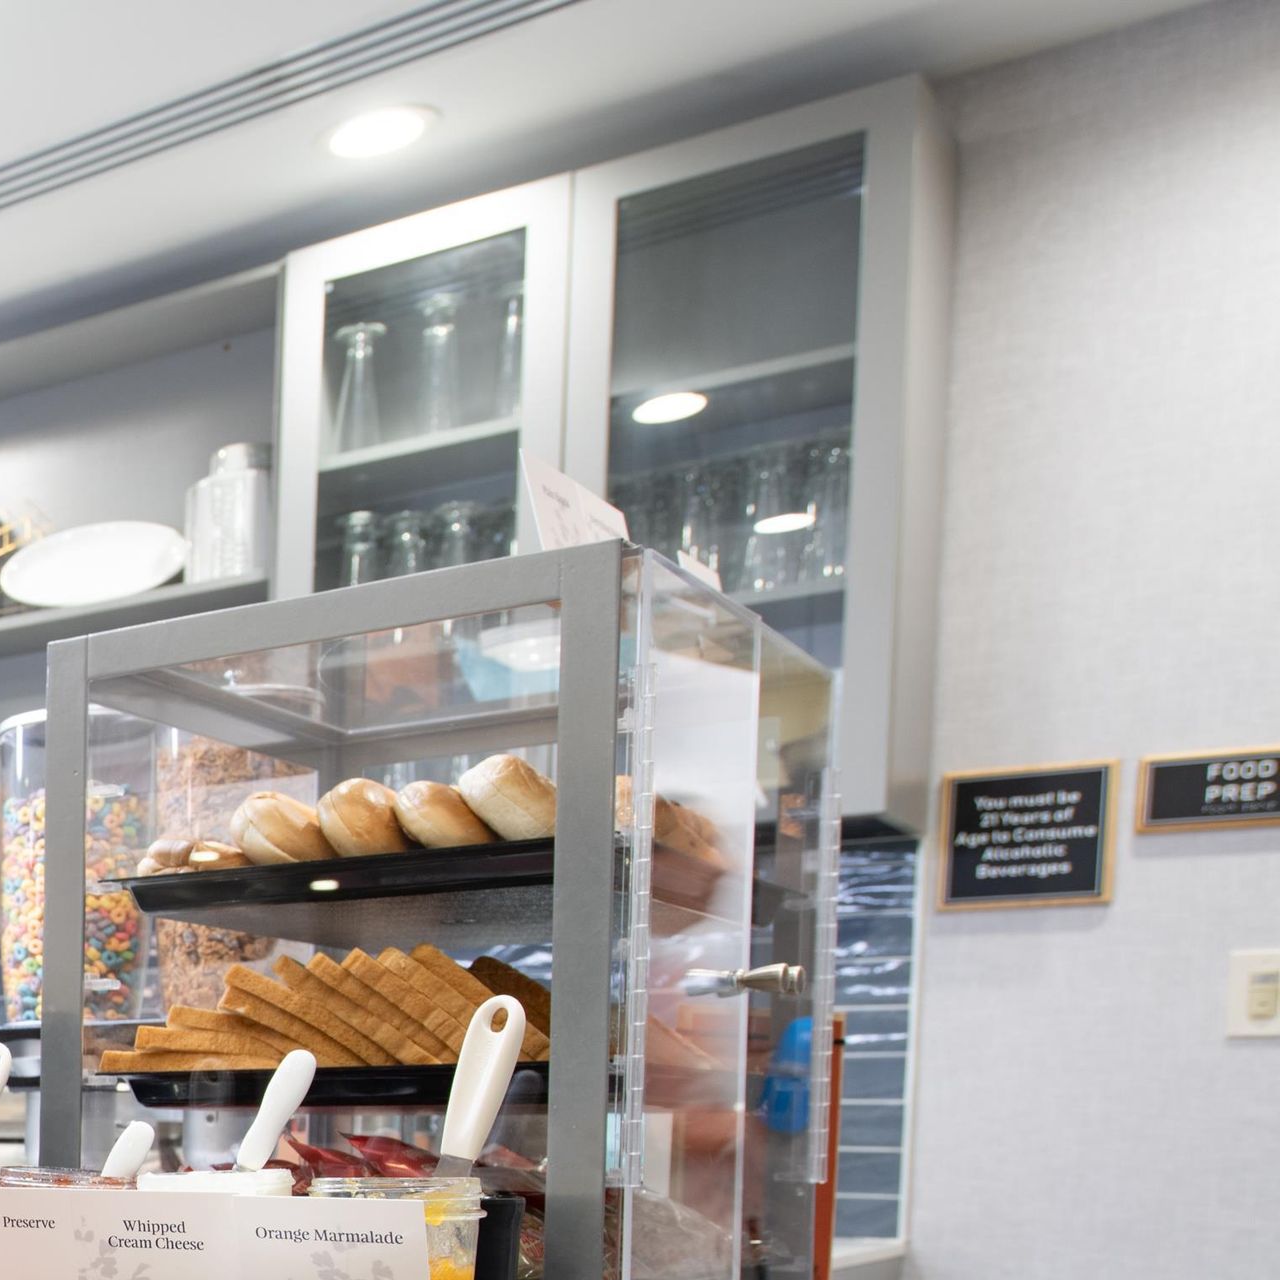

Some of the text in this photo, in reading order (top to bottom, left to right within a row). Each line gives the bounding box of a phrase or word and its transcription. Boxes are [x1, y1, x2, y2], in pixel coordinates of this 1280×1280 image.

[1206, 759, 1278, 782] FOOD
[974, 790, 1082, 811] You must be
[1204, 781, 1277, 804] PREP
[1001, 810, 1052, 826] Years
[1053, 806, 1075, 823] of
[954, 825, 1098, 848] Age to Consume
[981, 843, 1068, 861] Alcoholic
[975, 861, 1072, 879] Beverages
[3, 1216, 56, 1229] Preserve
[122, 1219, 187, 1236] Whipped
[108, 1235, 205, 1251] Cream Cheese
[255, 1226, 404, 1246] Orange Marmalade
